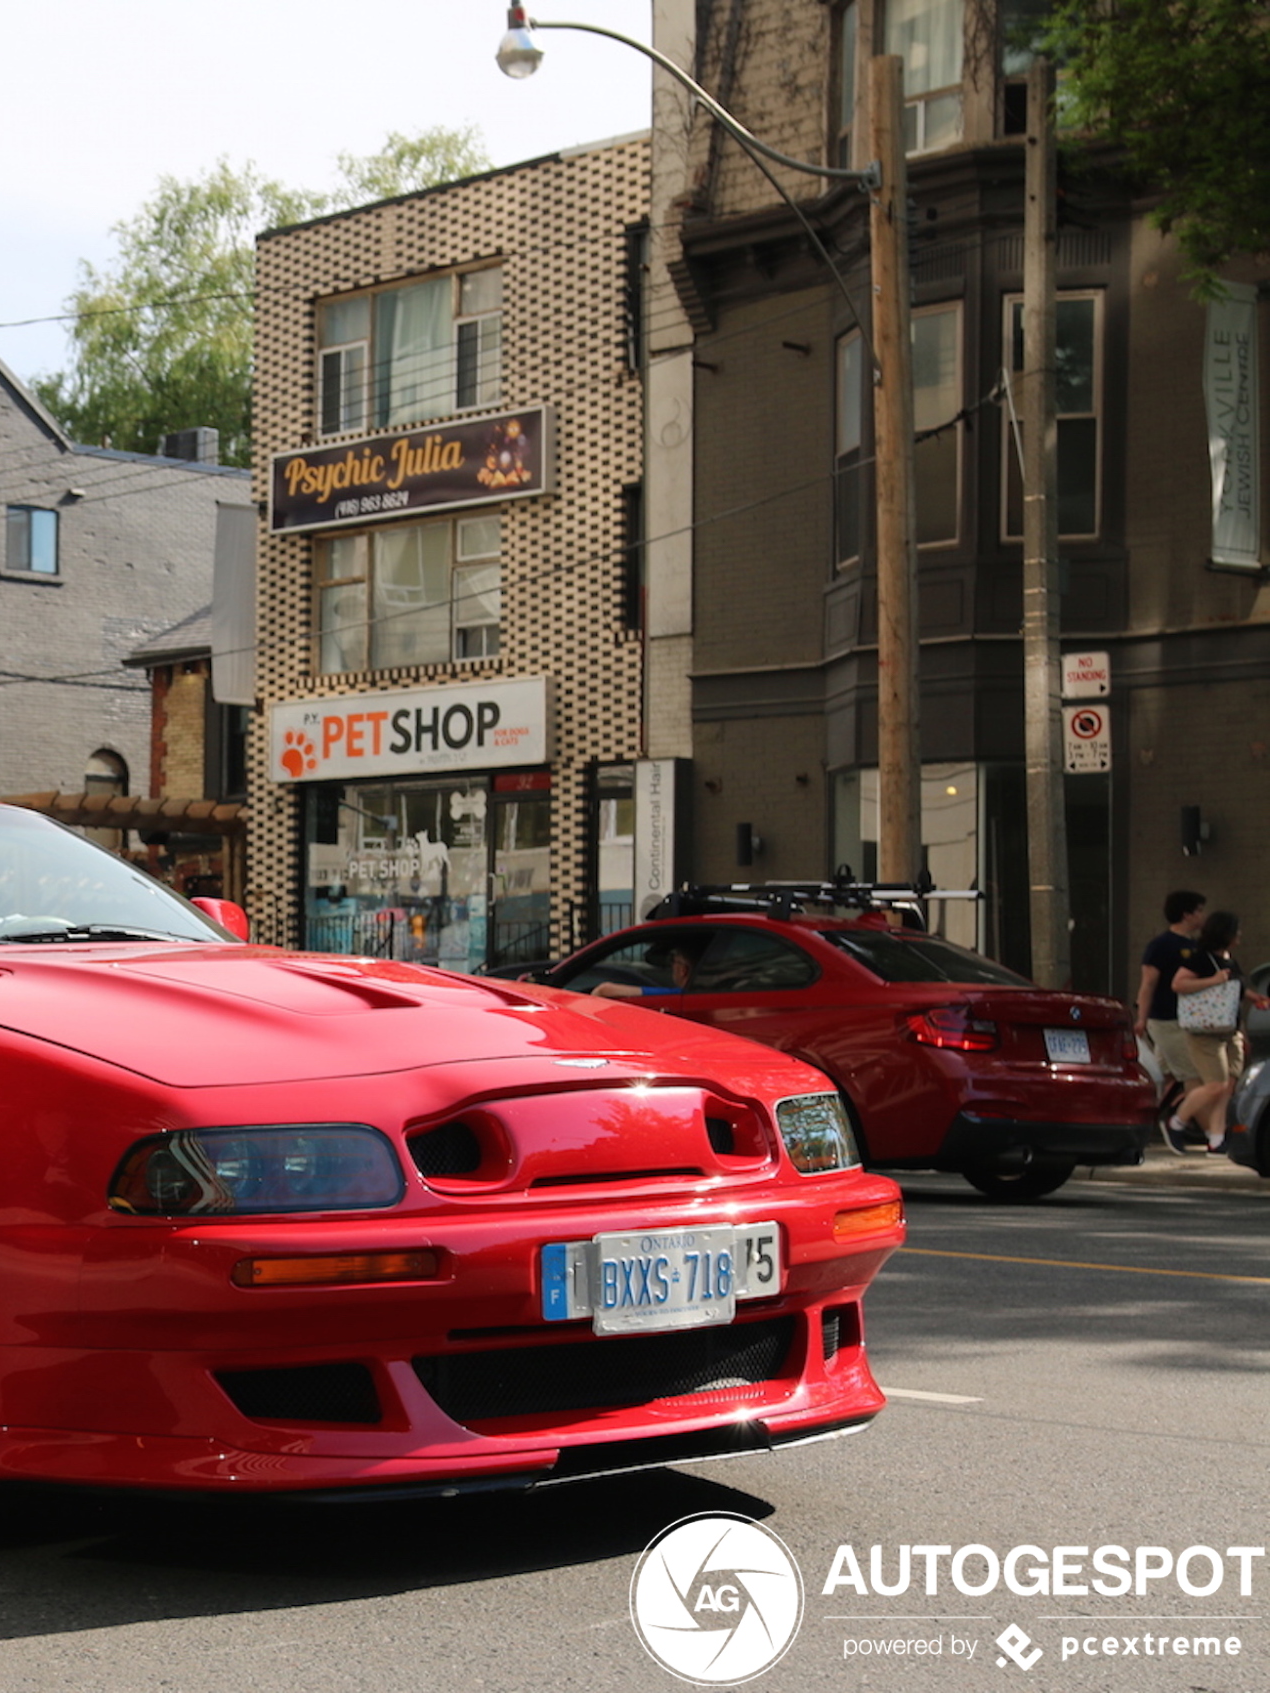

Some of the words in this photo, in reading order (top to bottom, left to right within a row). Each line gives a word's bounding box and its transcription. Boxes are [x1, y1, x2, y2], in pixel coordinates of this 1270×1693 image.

[285, 447, 386, 503] Psychic
[386, 434, 466, 489] Julia
[1237, 433, 1251, 519] JEWISH
[1078, 657, 1093, 668] NO
[1066, 669, 1107, 683] STANDING
[649, 762, 661, 796] Hair
[648, 800, 661, 891] Continental
[348, 860, 376, 879] PET
[378, 858, 420, 878] SHOP
[640, 1234, 695, 1253] ONTARIO
[550, 1289, 560, 1305] F
